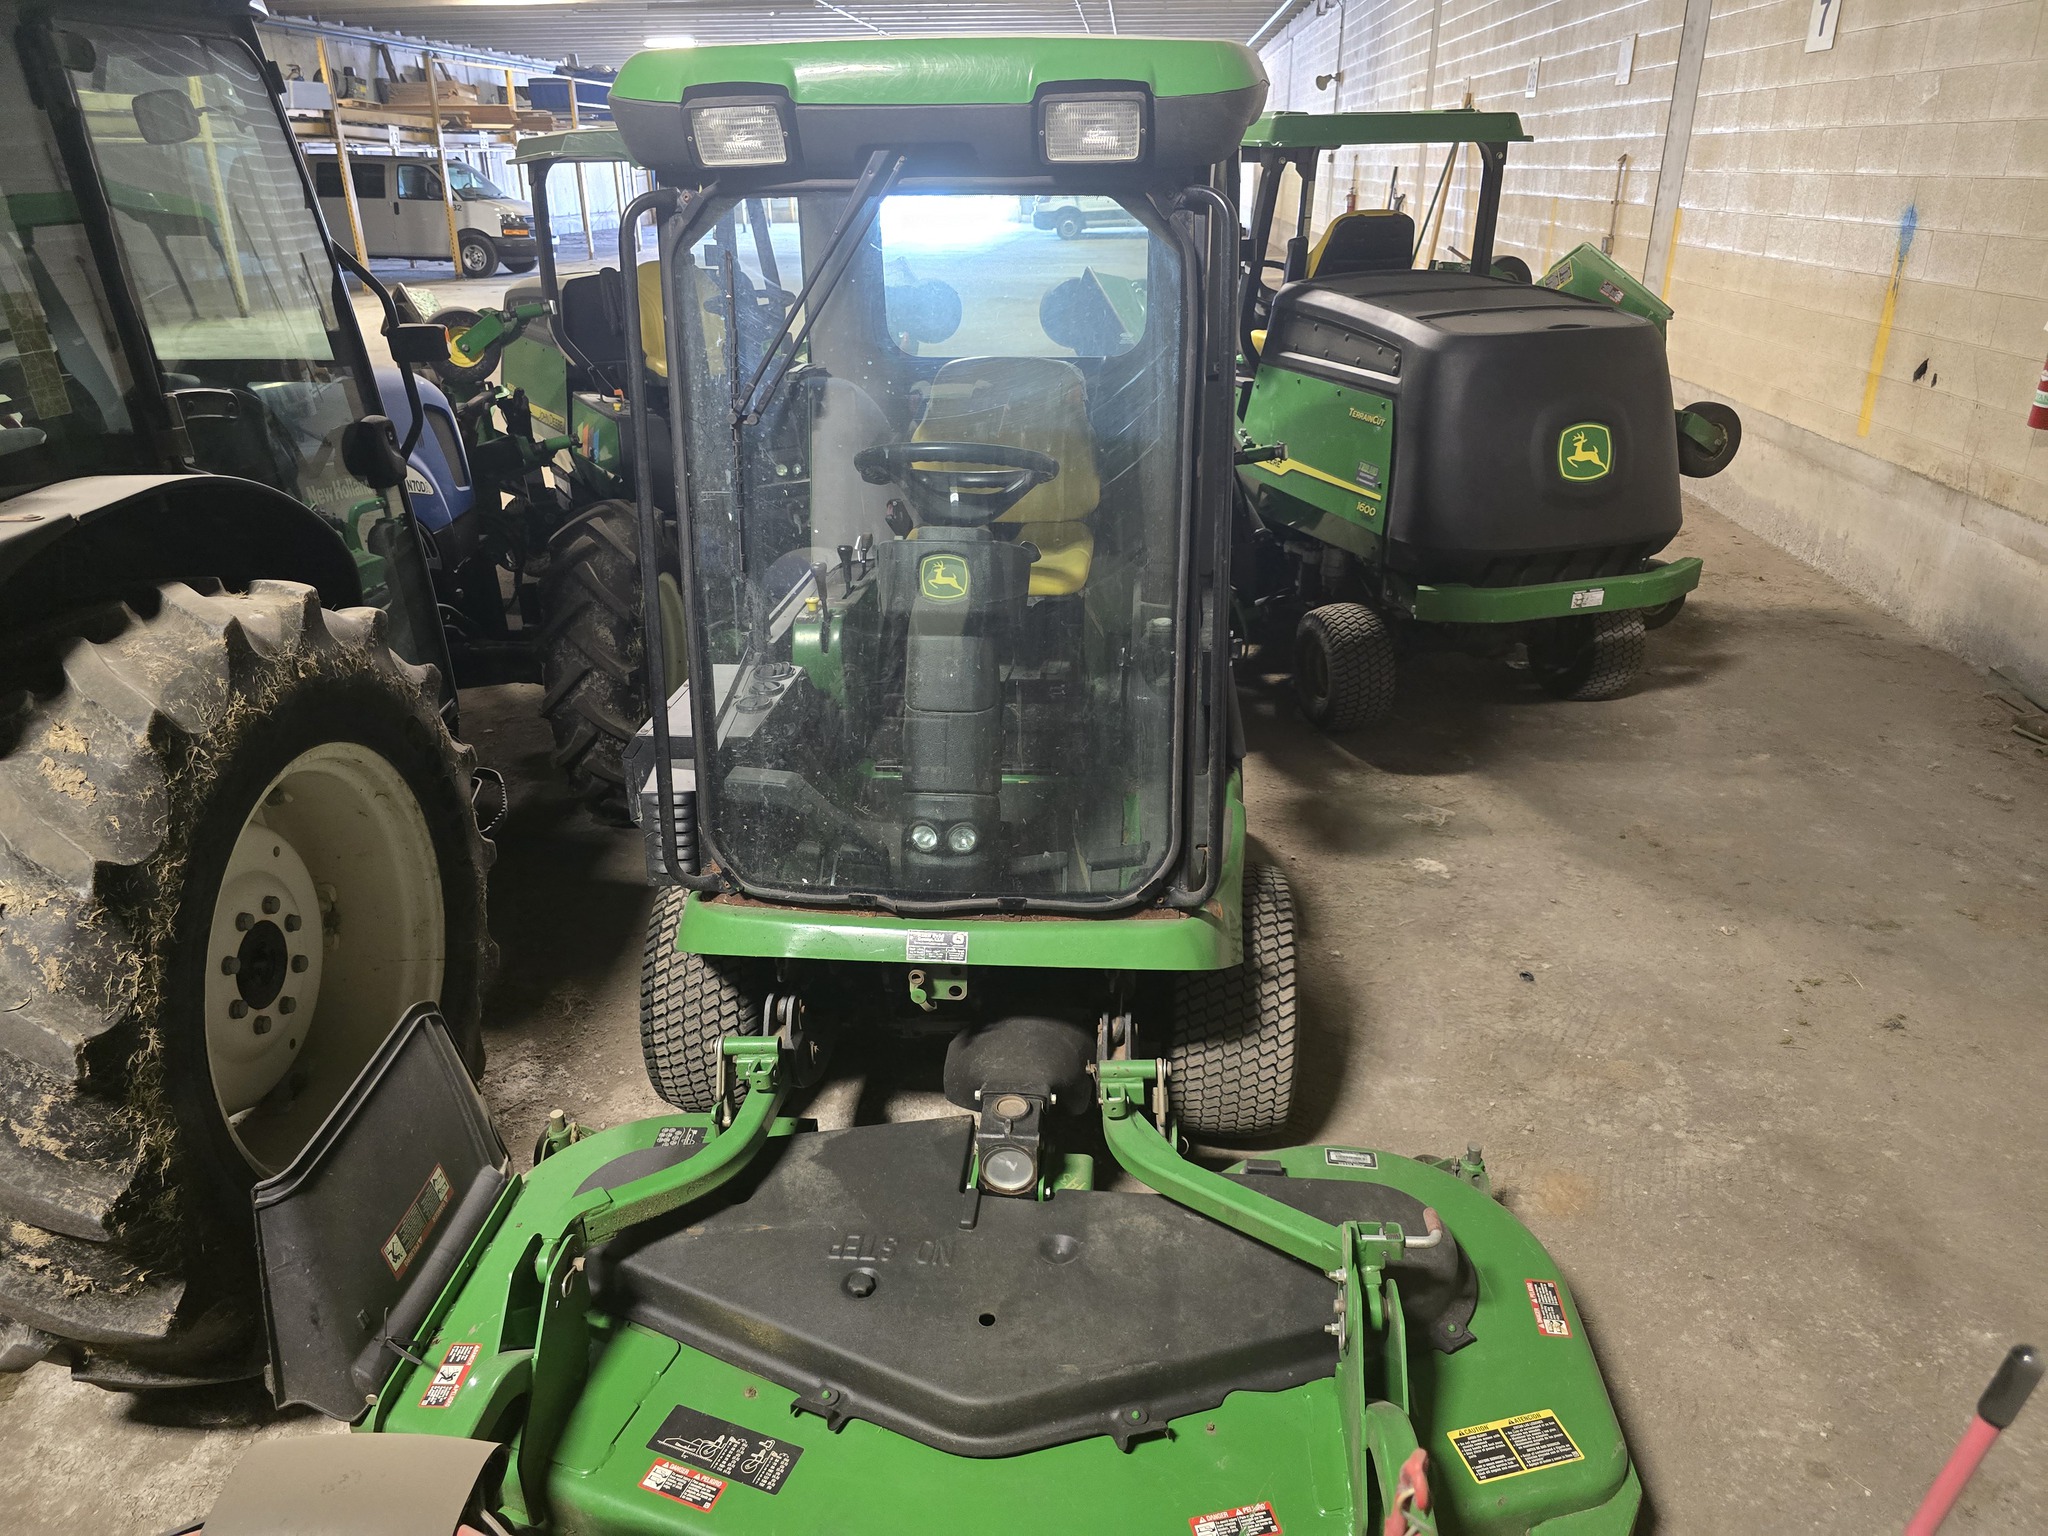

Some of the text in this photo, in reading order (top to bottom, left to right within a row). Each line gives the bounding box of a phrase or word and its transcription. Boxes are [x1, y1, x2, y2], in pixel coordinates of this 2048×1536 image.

[1819, 0, 1832, 37] 7
[389, 132, 399, 144] 13
[306, 485, 333, 505] New
[1356, 501, 1377, 517] 1600
[1463, 1424, 1489, 1435] CAUTION
[669, 1463, 690, 1476] DANGER
[700, 1474, 723, 1487] PELIGRO
[1206, 1511, 1229, 1522] DANGER
